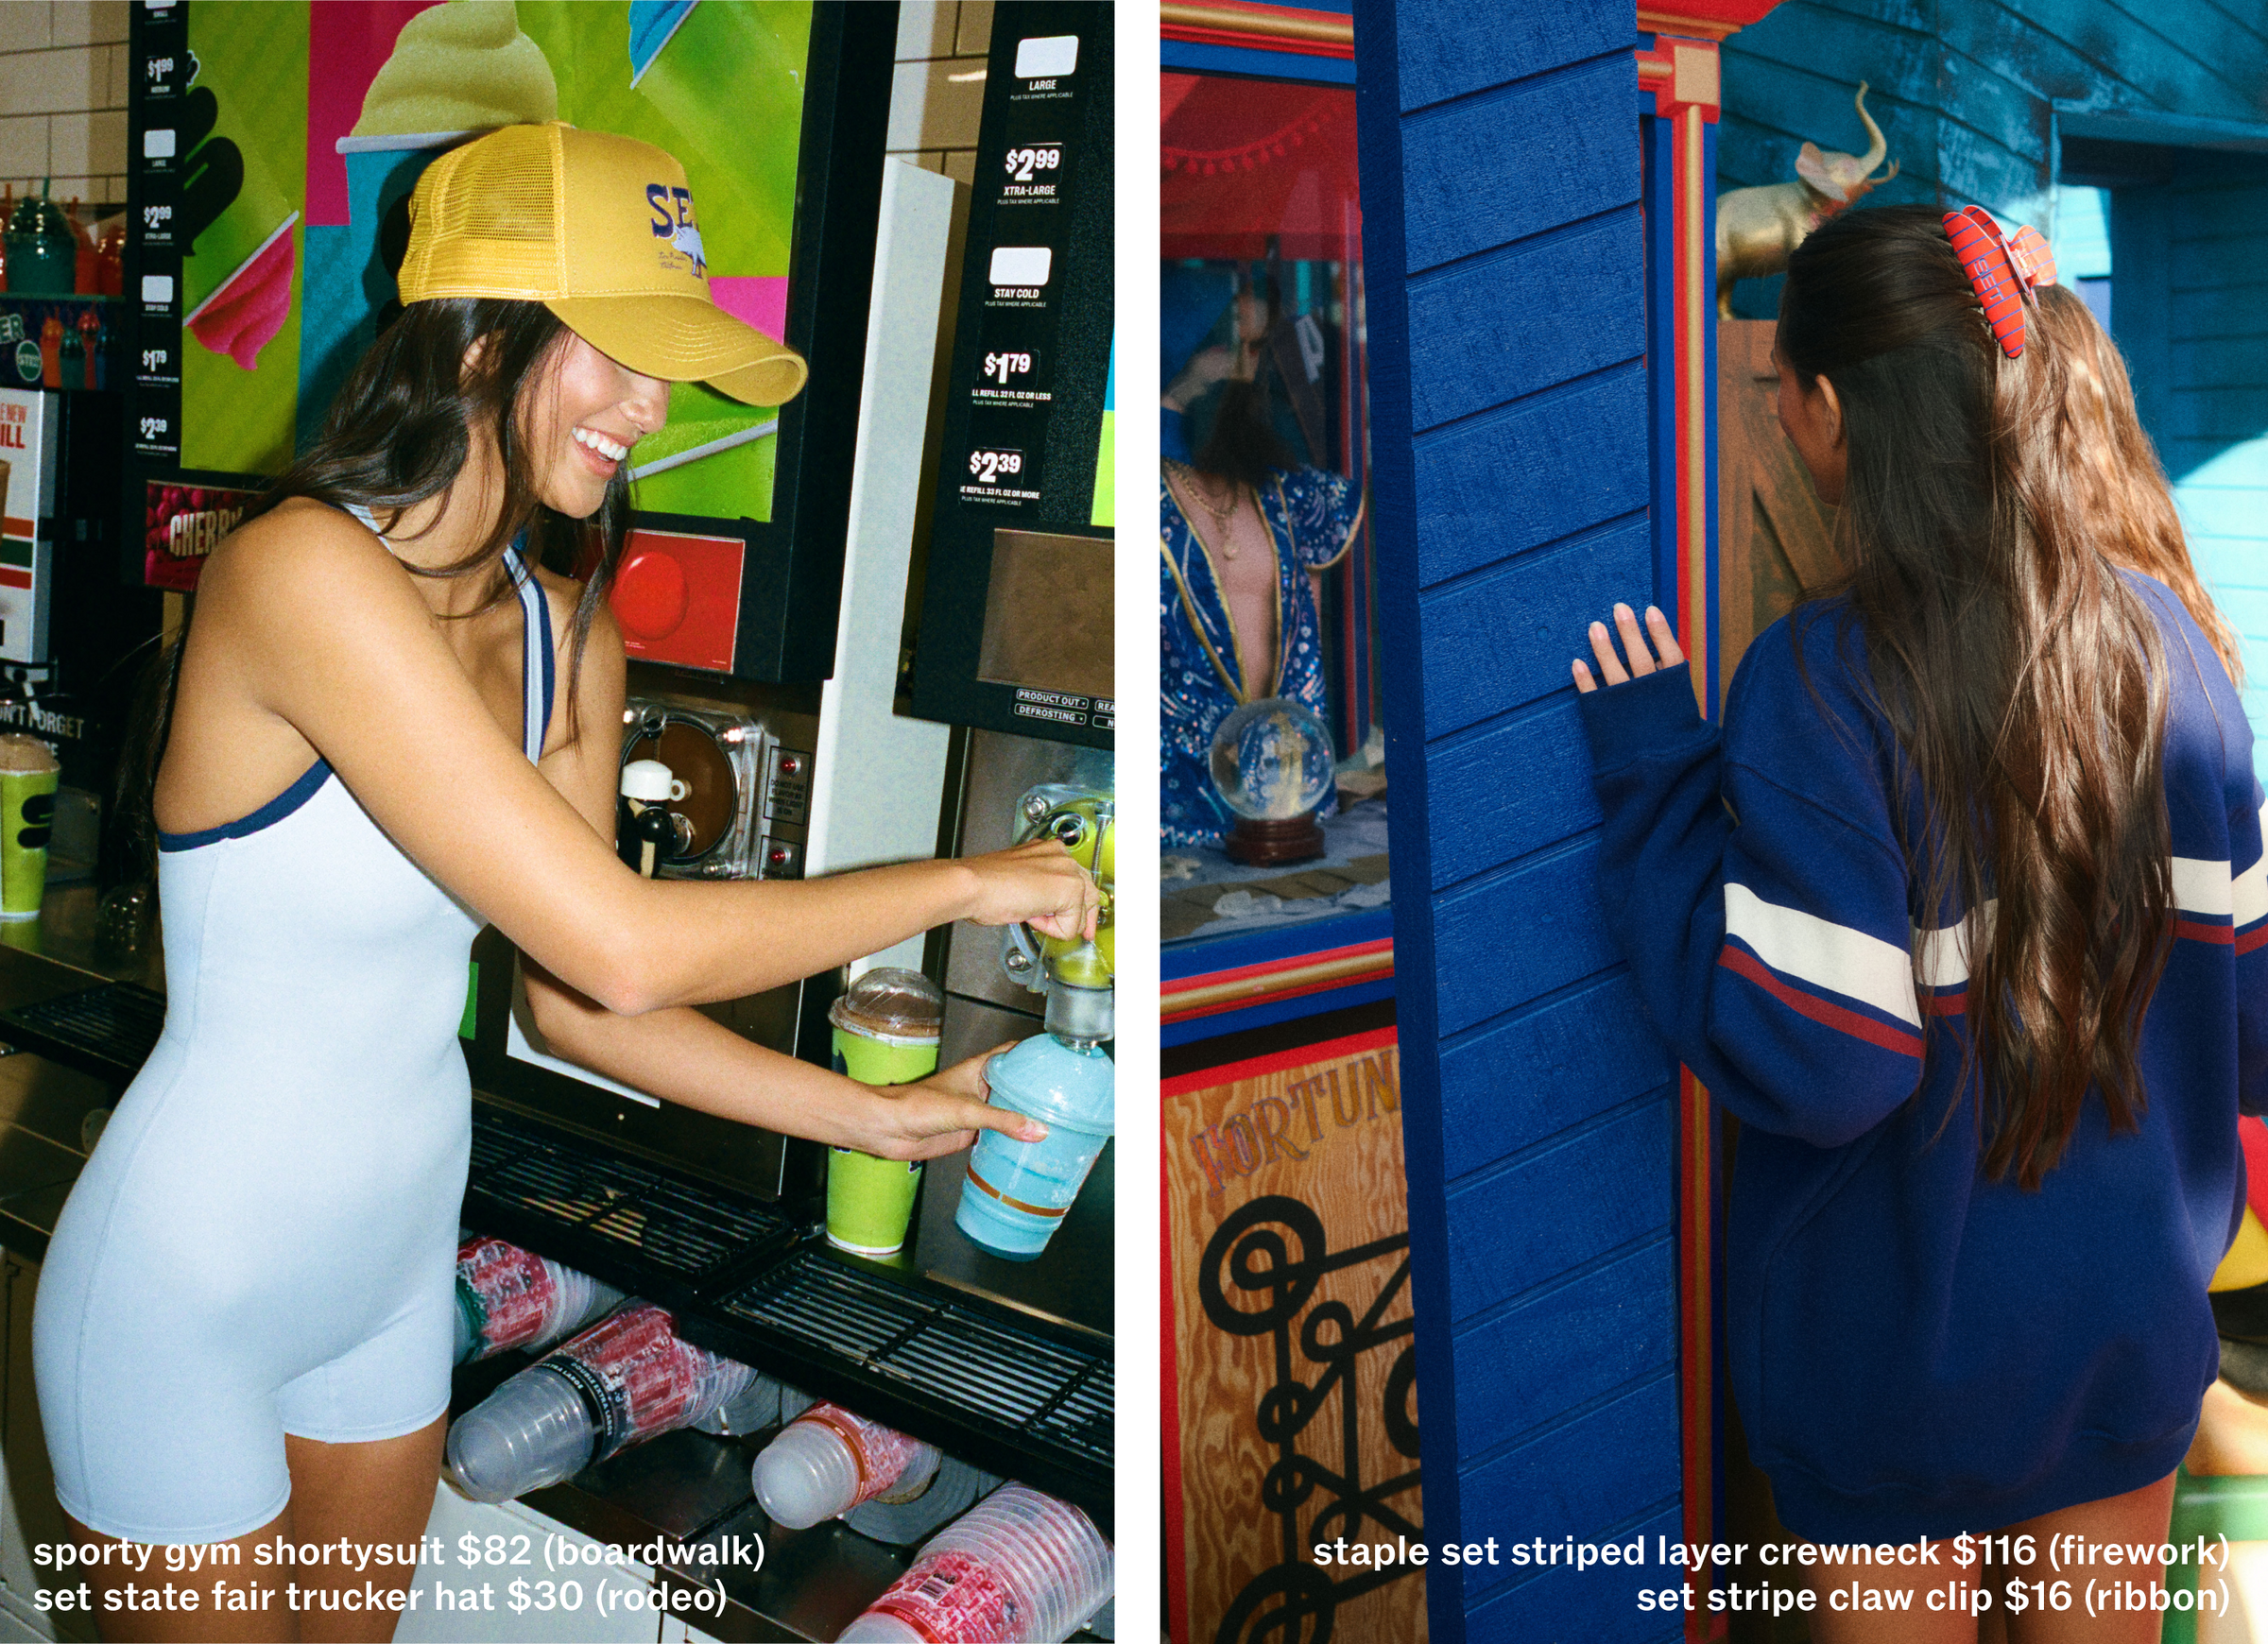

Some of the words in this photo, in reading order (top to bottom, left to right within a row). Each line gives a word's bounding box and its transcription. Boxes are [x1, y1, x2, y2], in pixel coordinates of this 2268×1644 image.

[148, 58, 174, 82] $199
[1029, 79, 1057, 91] LARGE
[1005, 148, 1060, 181] $299
[1004, 184, 1056, 197] XTRA-LARGE
[144, 206, 172, 229] $299
[645, 182, 699, 238] SE
[1973, 257, 2005, 301] SET
[994, 287, 1016, 299] STAY
[1016, 288, 1040, 300] COLD
[143, 350, 167, 372] $179
[984, 351, 1031, 384] $179
[979, 389, 999, 398] REFILL
[1000, 390, 1008, 399] 32
[1008, 390, 1016, 399] FL
[1016, 391, 1025, 400] OZ
[1025, 391, 1035, 400] OR
[1035, 392, 1052, 401] LESS
[6, 403, 28, 424] NEW
[140, 417, 168, 440] $239
[970, 451, 1022, 484] $239
[966, 486, 986, 495] REFILL
[986, 488, 995, 496] 33
[1003, 488, 1012, 497] OZ
[1011, 489, 1021, 498] OR
[1021, 490, 1040, 500] MORE
[1019, 691, 1060, 704] PRODUCT
[1061, 696, 1080, 707] OUT
[0, 703, 26, 727] N'T
[1019, 706, 1076, 722] DEFROSTING
[1191, 1048, 1400, 1197] FORTUN
[571, 1361, 596, 1385] DOUBLE
[593, 1383, 609, 1410] EXTRA
